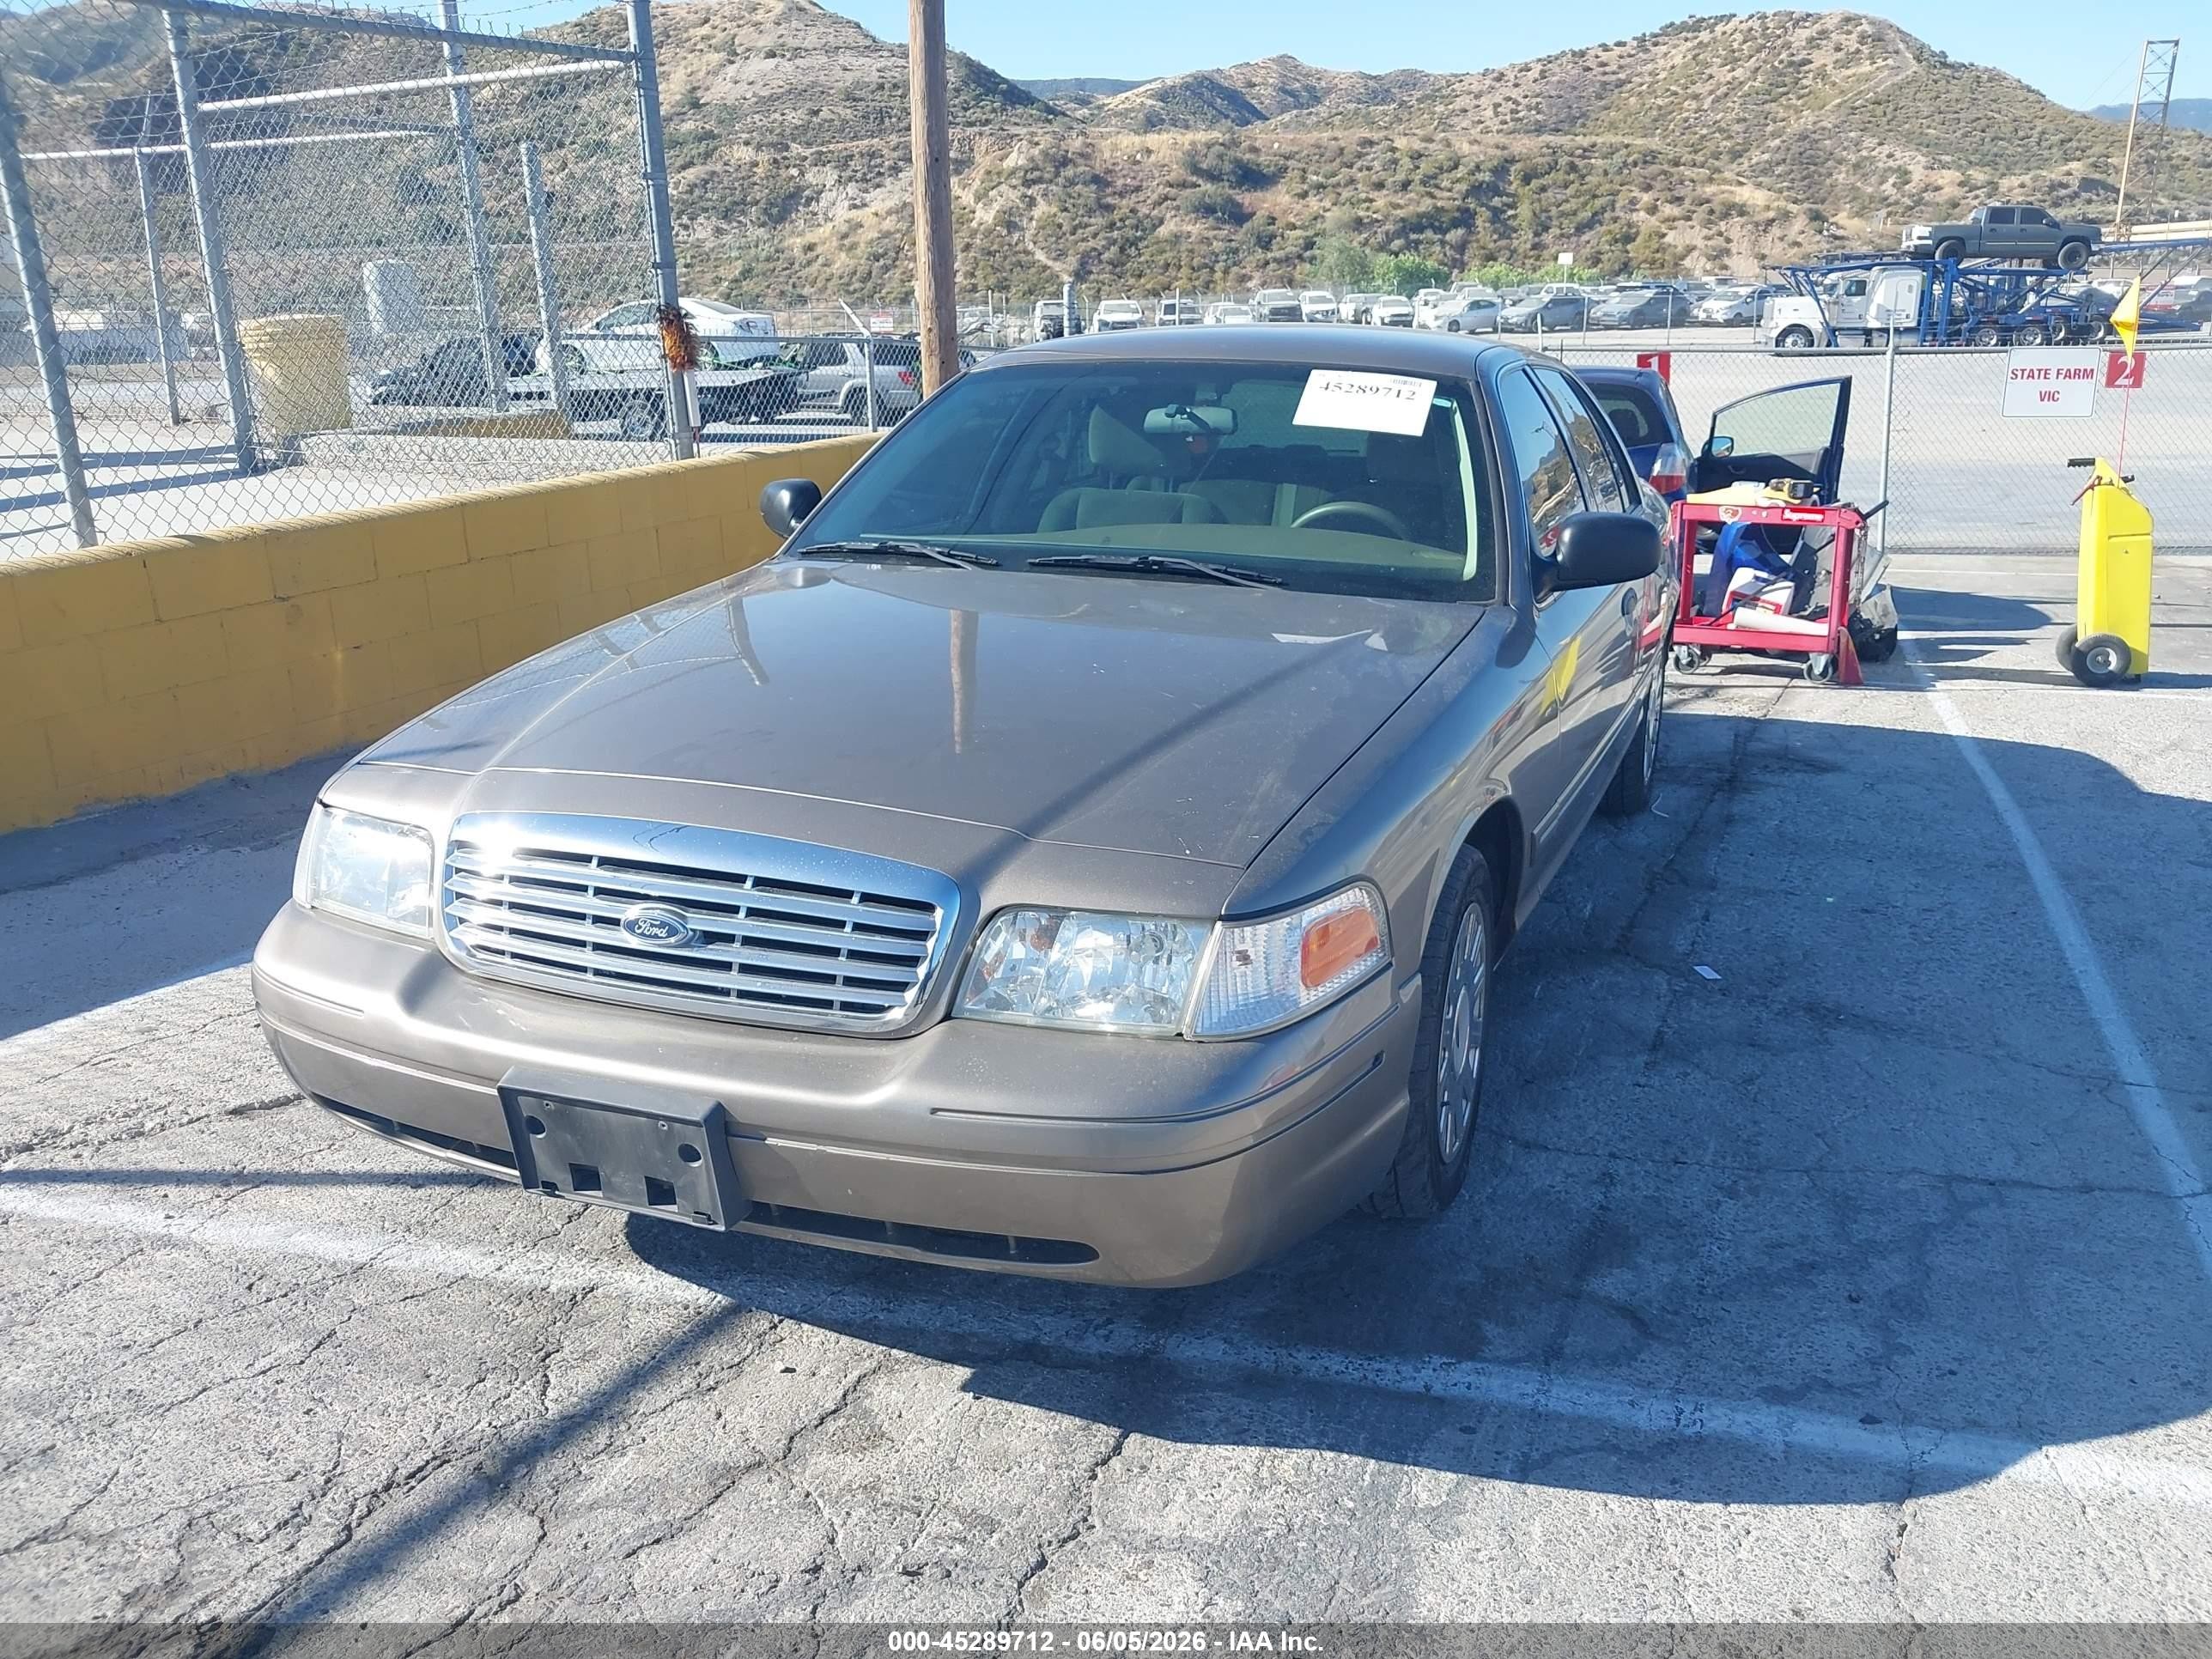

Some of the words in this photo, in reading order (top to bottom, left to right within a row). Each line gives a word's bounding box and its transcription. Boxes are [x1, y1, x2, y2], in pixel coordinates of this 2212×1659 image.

[2010, 368, 2051, 380] STATE
[2056, 368, 2095, 380] FARM
[2113, 356, 2136, 386] 2
[1319, 380, 1416, 401] 45289712
[2039, 390, 2060, 403] VIC
[635, 918, 668, 938] Ford
